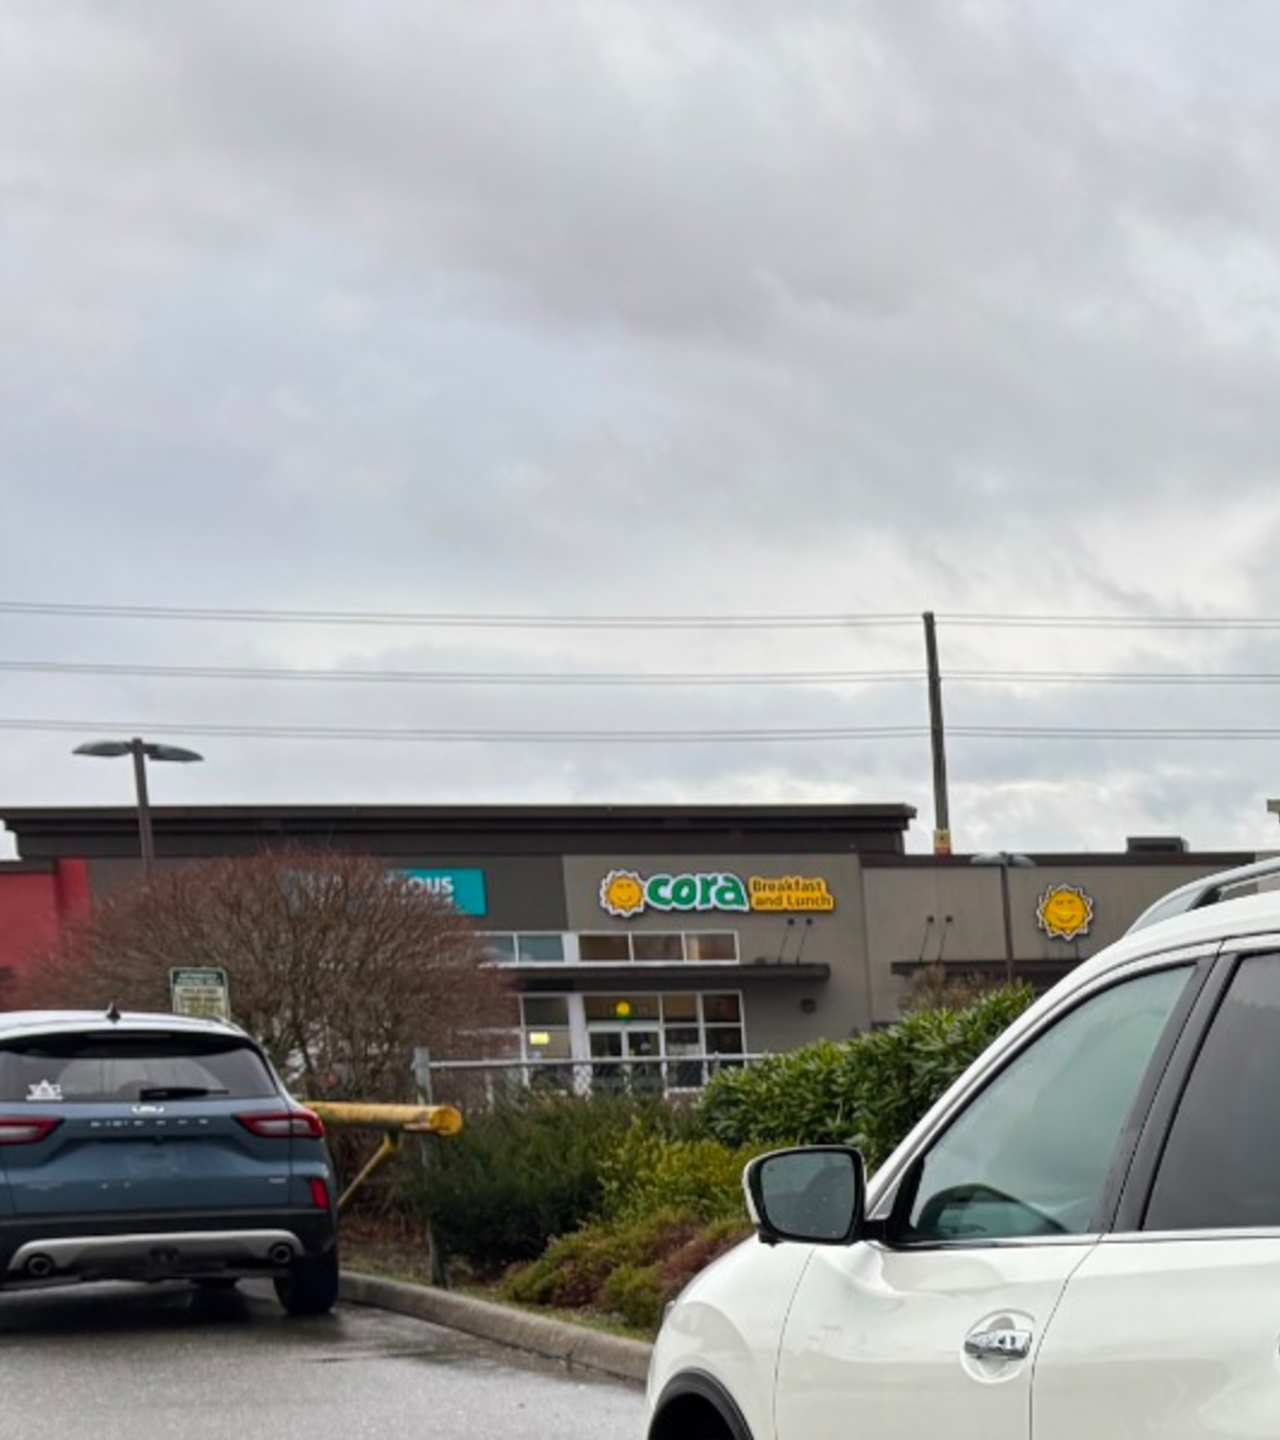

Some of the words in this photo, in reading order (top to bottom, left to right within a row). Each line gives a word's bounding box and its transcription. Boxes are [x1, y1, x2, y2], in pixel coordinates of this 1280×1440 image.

[647, 875, 746, 906] cora
[752, 878, 823, 893] Breakfast
[755, 894, 783, 906] and
[787, 893, 832, 907] Lunch
